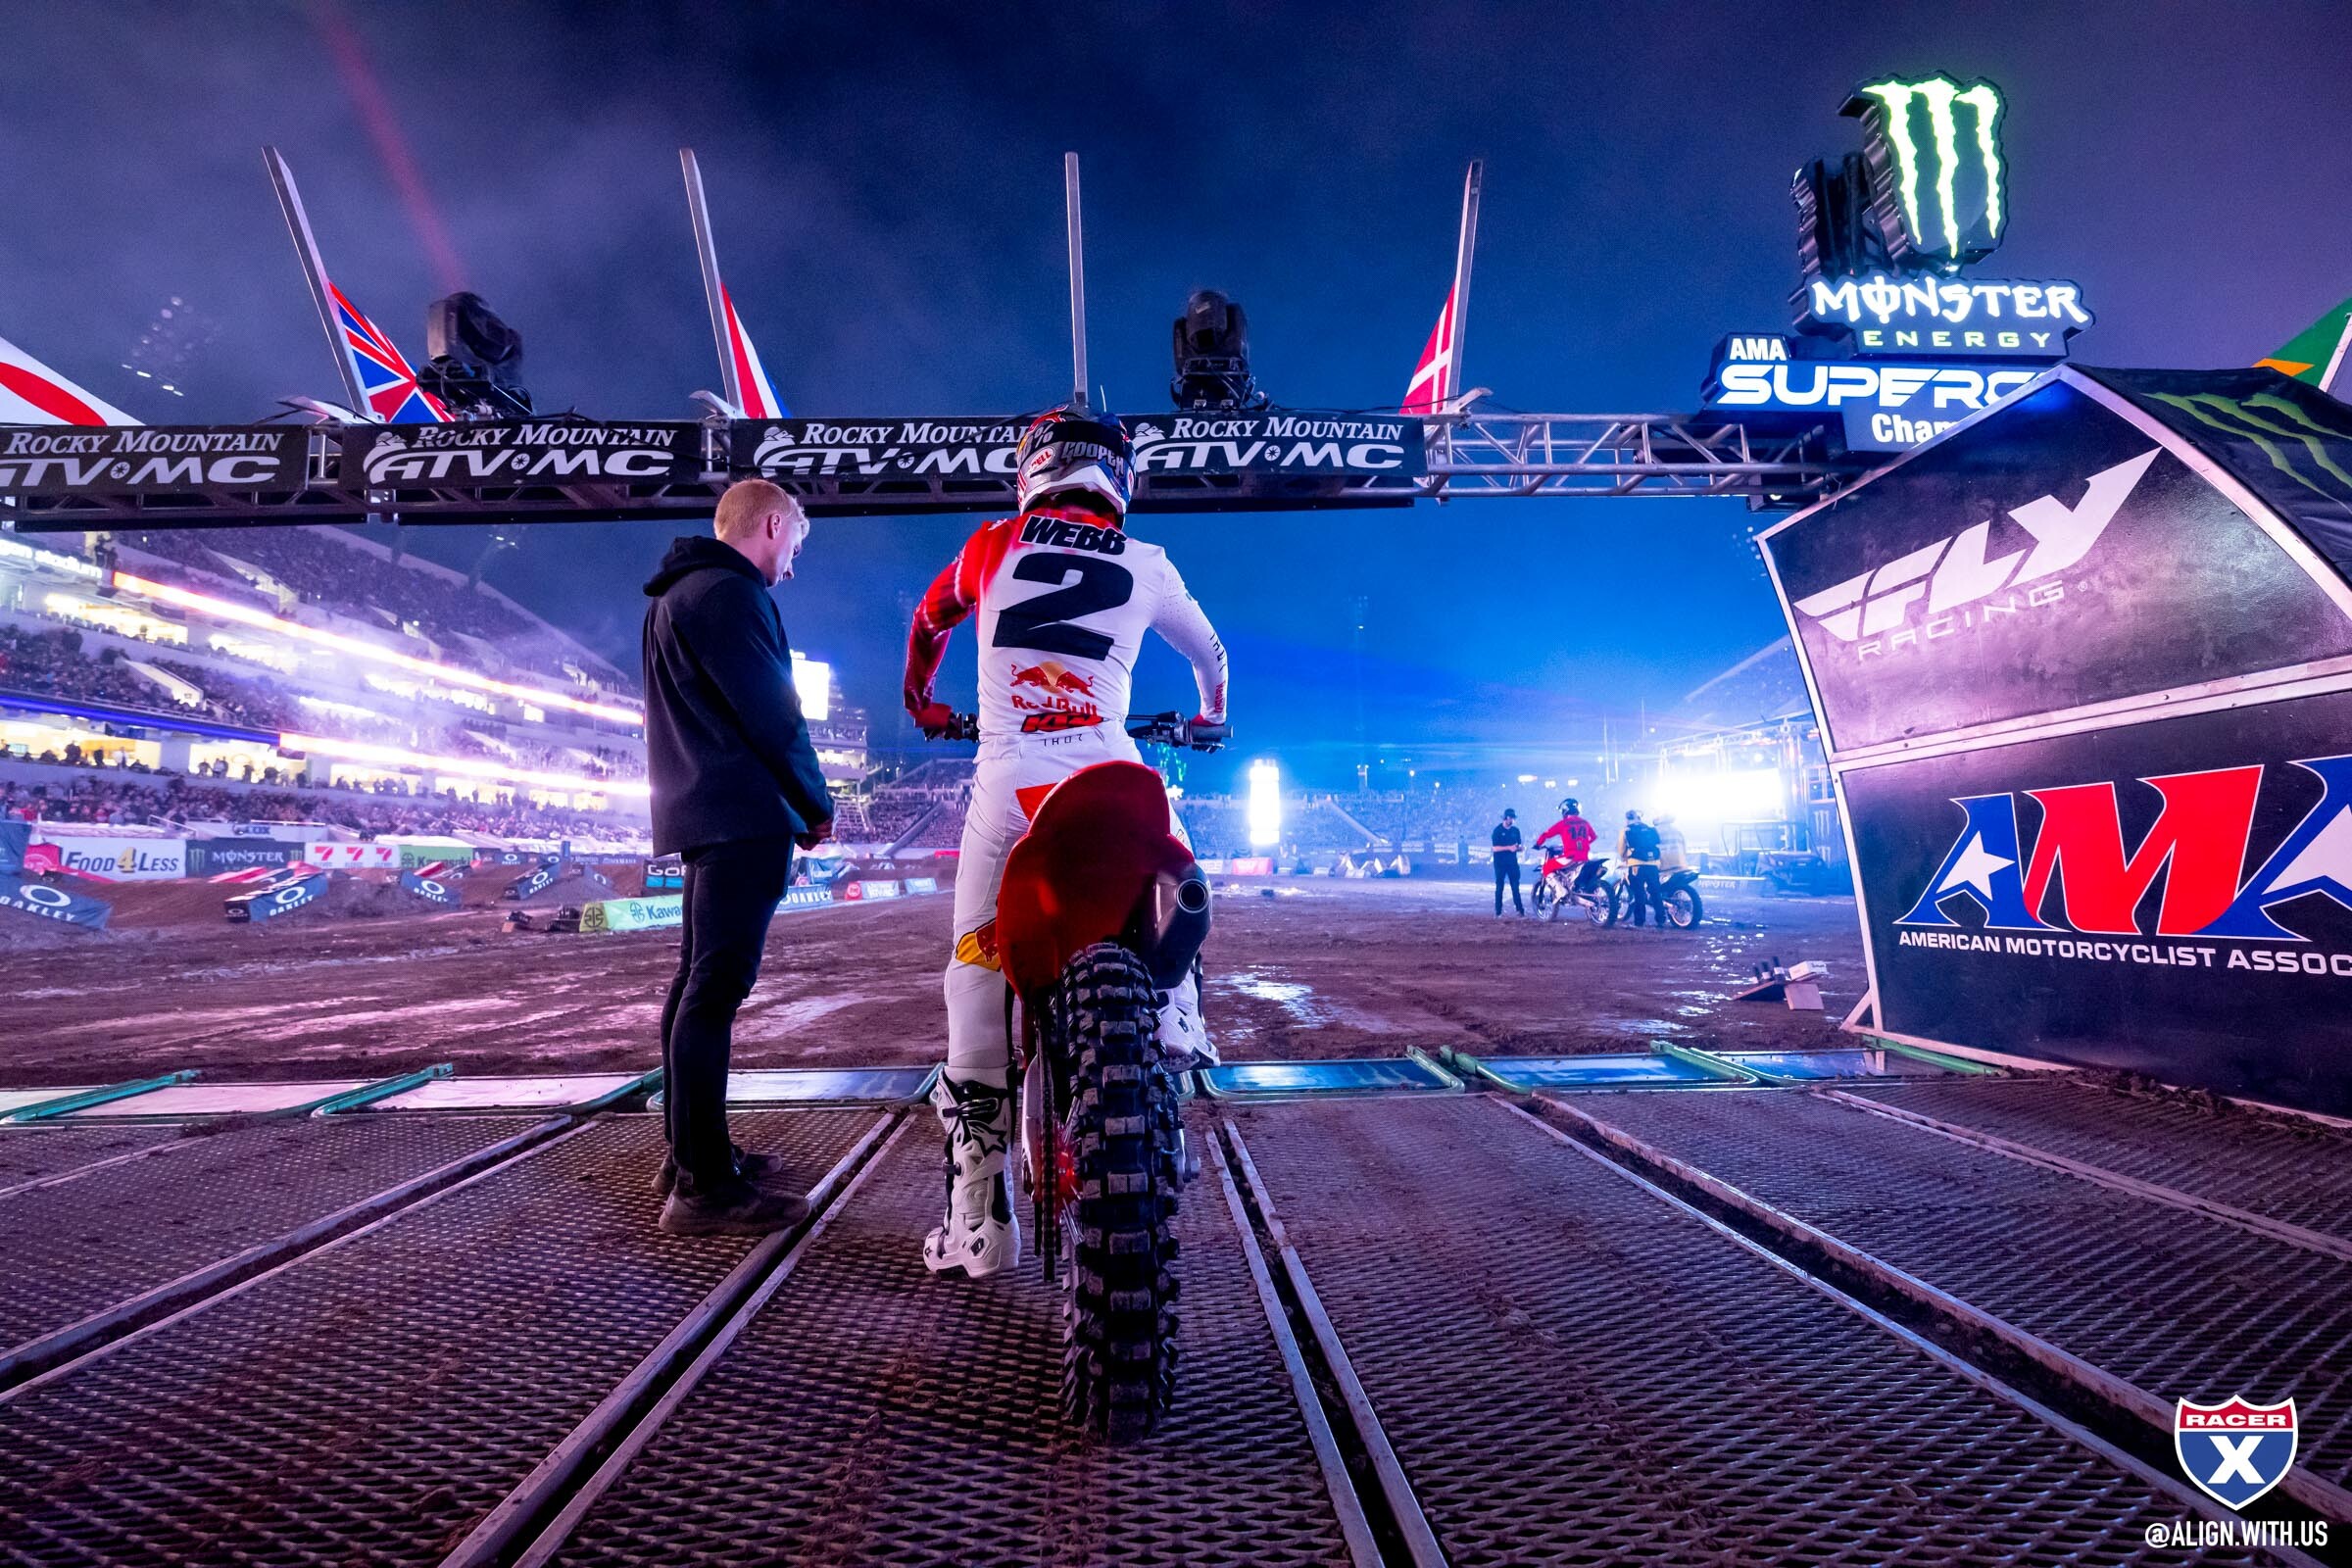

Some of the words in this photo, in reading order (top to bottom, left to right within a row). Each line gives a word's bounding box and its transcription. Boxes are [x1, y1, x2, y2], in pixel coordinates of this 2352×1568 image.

[1810, 275, 2089, 324] MONSTER
[1730, 338, 1788, 361] AMA
[1863, 329, 2051, 348] ENERGY
[1716, 364, 2048, 410] SUPERC
[410, 426, 512, 448] ROCKY
[512, 423, 678, 447] MOUNTAIN
[800, 422, 894, 444] ROCKY
[896, 422, 1031, 444] MOUNTAI
[1170, 417, 1258, 439] ROCKY
[1262, 416, 1403, 440] MOUNTAIN
[3, 432, 110, 454] ROCKY
[112, 430, 284, 454] MOUNTAIN
[1021, 515, 1127, 556] WEBB
[1793, 446, 2164, 643] FLY
[992, 552, 1134, 662] 2
[1856, 578, 2065, 662] RACING
[66, 852, 116, 872] FOOD
[117, 846, 137, 873] 4
[138, 852, 179, 872] LESS
[213, 850, 284, 863] MONSTER
[0, 896, 76, 922] OAKLEY
[269, 894, 314, 916] OAKLEY
[1898, 931, 2000, 954] AMERICAN
[2005, 937, 2216, 968] MOTORCYCLIST
